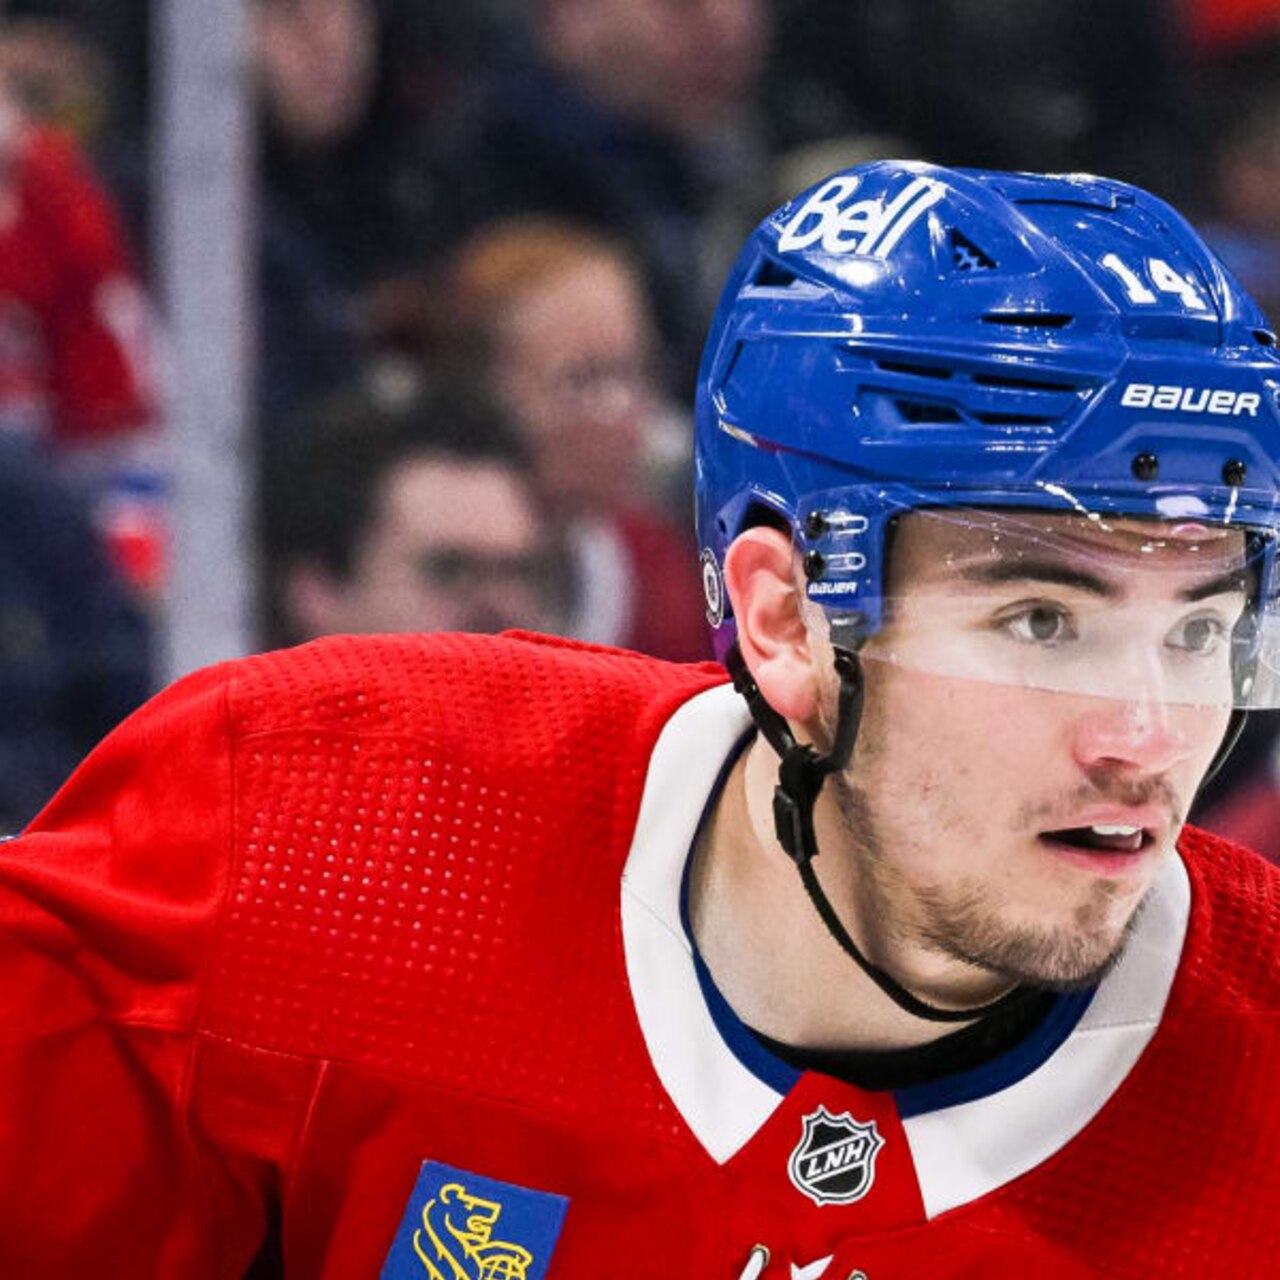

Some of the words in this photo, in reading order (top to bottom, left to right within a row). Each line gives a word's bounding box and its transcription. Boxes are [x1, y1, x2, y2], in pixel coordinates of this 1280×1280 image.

[778, 175, 947, 260] Bell
[1102, 254, 1207, 310] 14
[1121, 383, 1261, 417] BAUER
[806, 1139, 865, 1178] LNH
